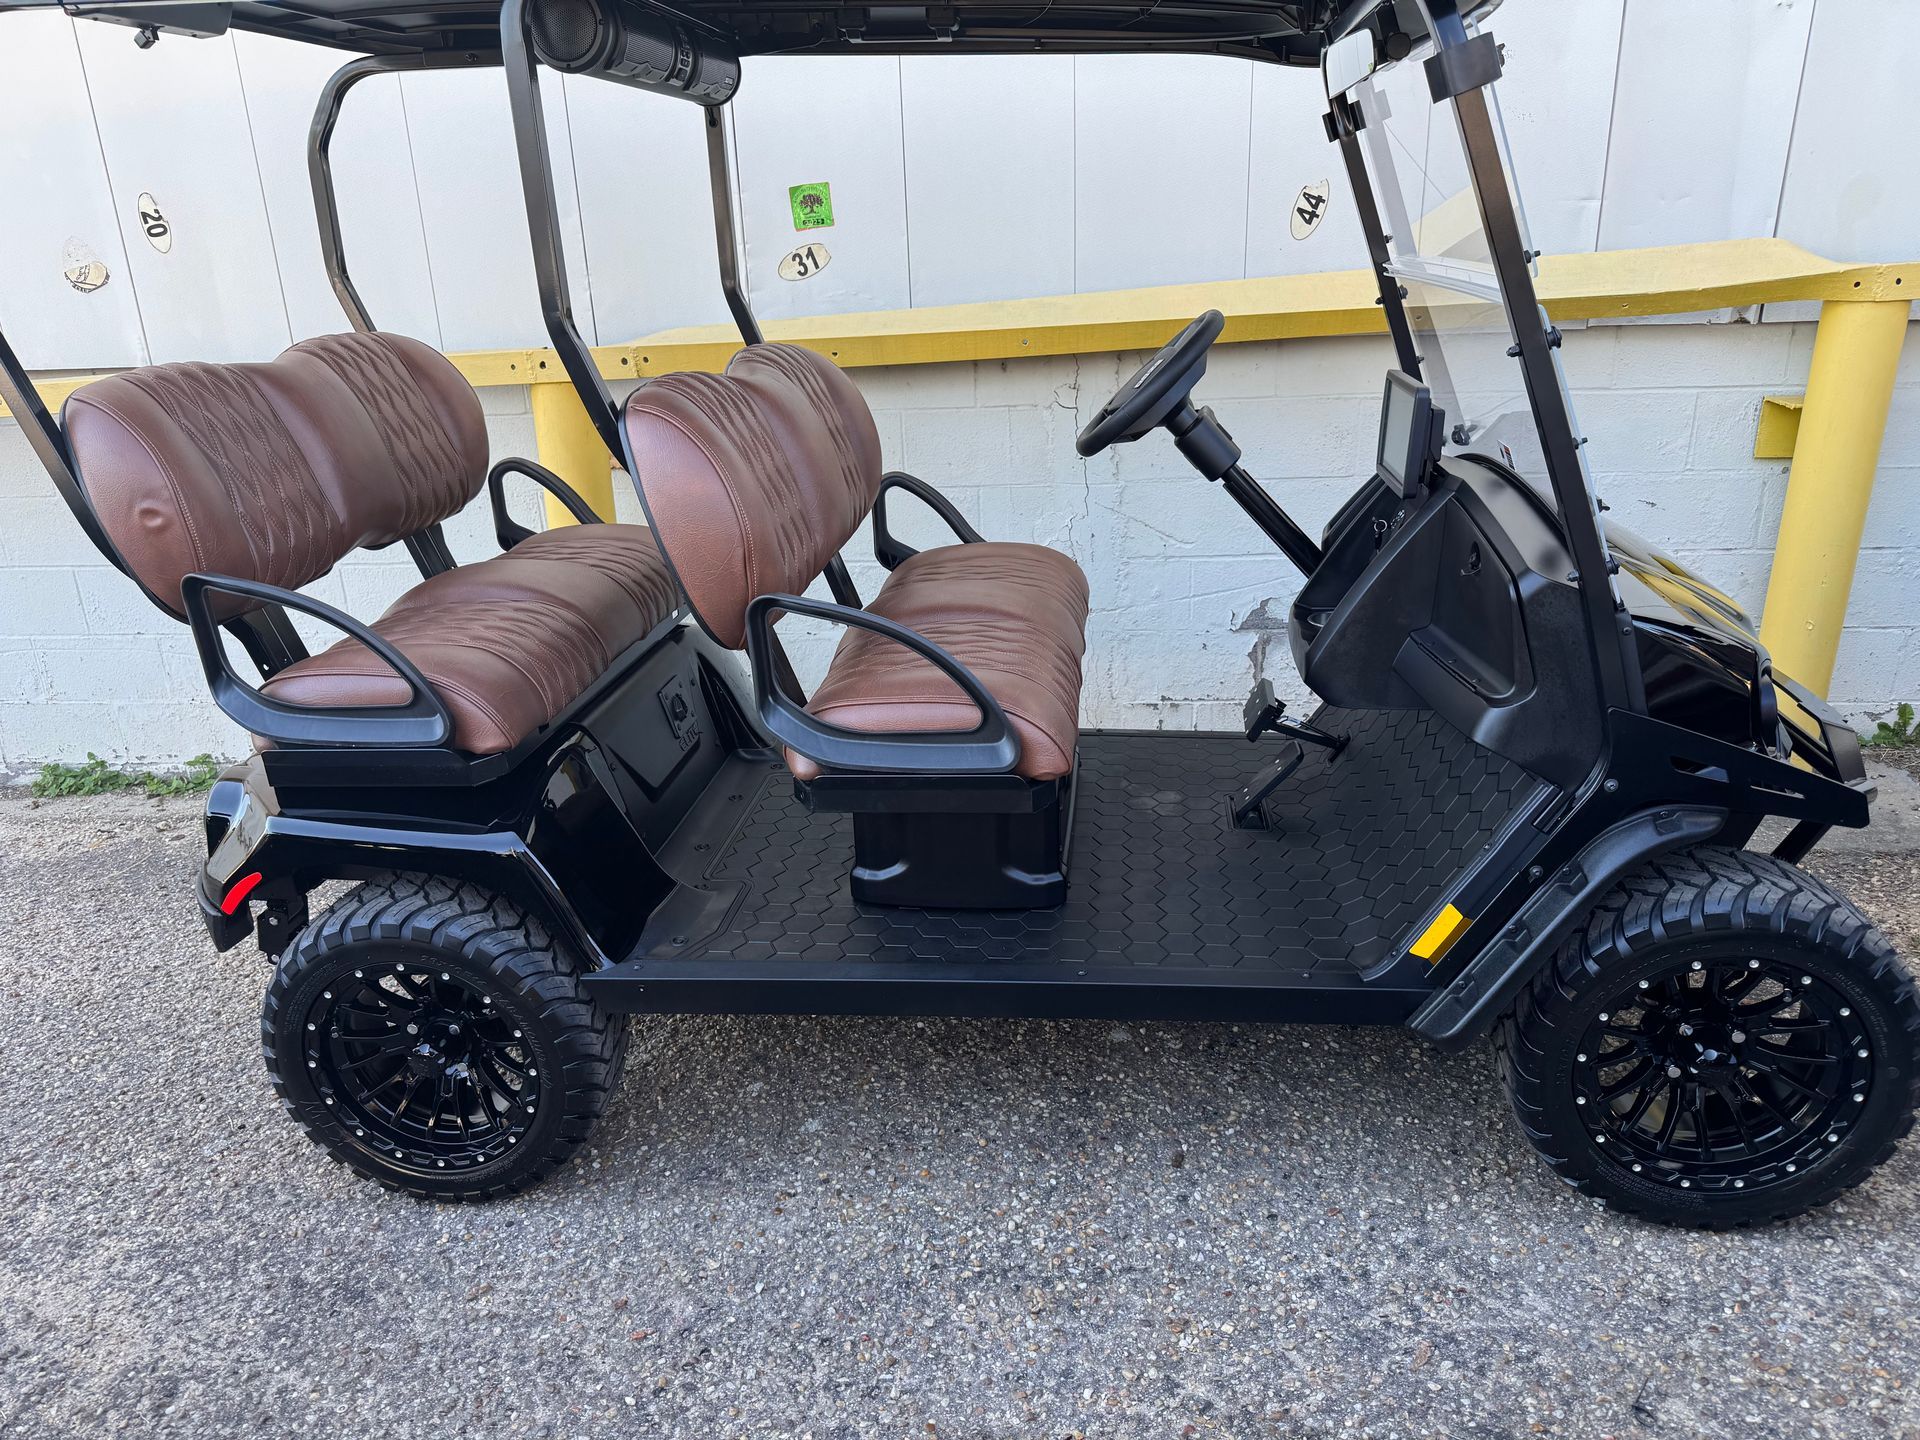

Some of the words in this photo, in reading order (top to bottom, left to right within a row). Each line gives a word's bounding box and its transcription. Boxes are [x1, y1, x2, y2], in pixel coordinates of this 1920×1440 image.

[140, 208, 168, 238] 20
[1296, 191, 1326, 226] 44
[791, 246, 820, 277] 31
